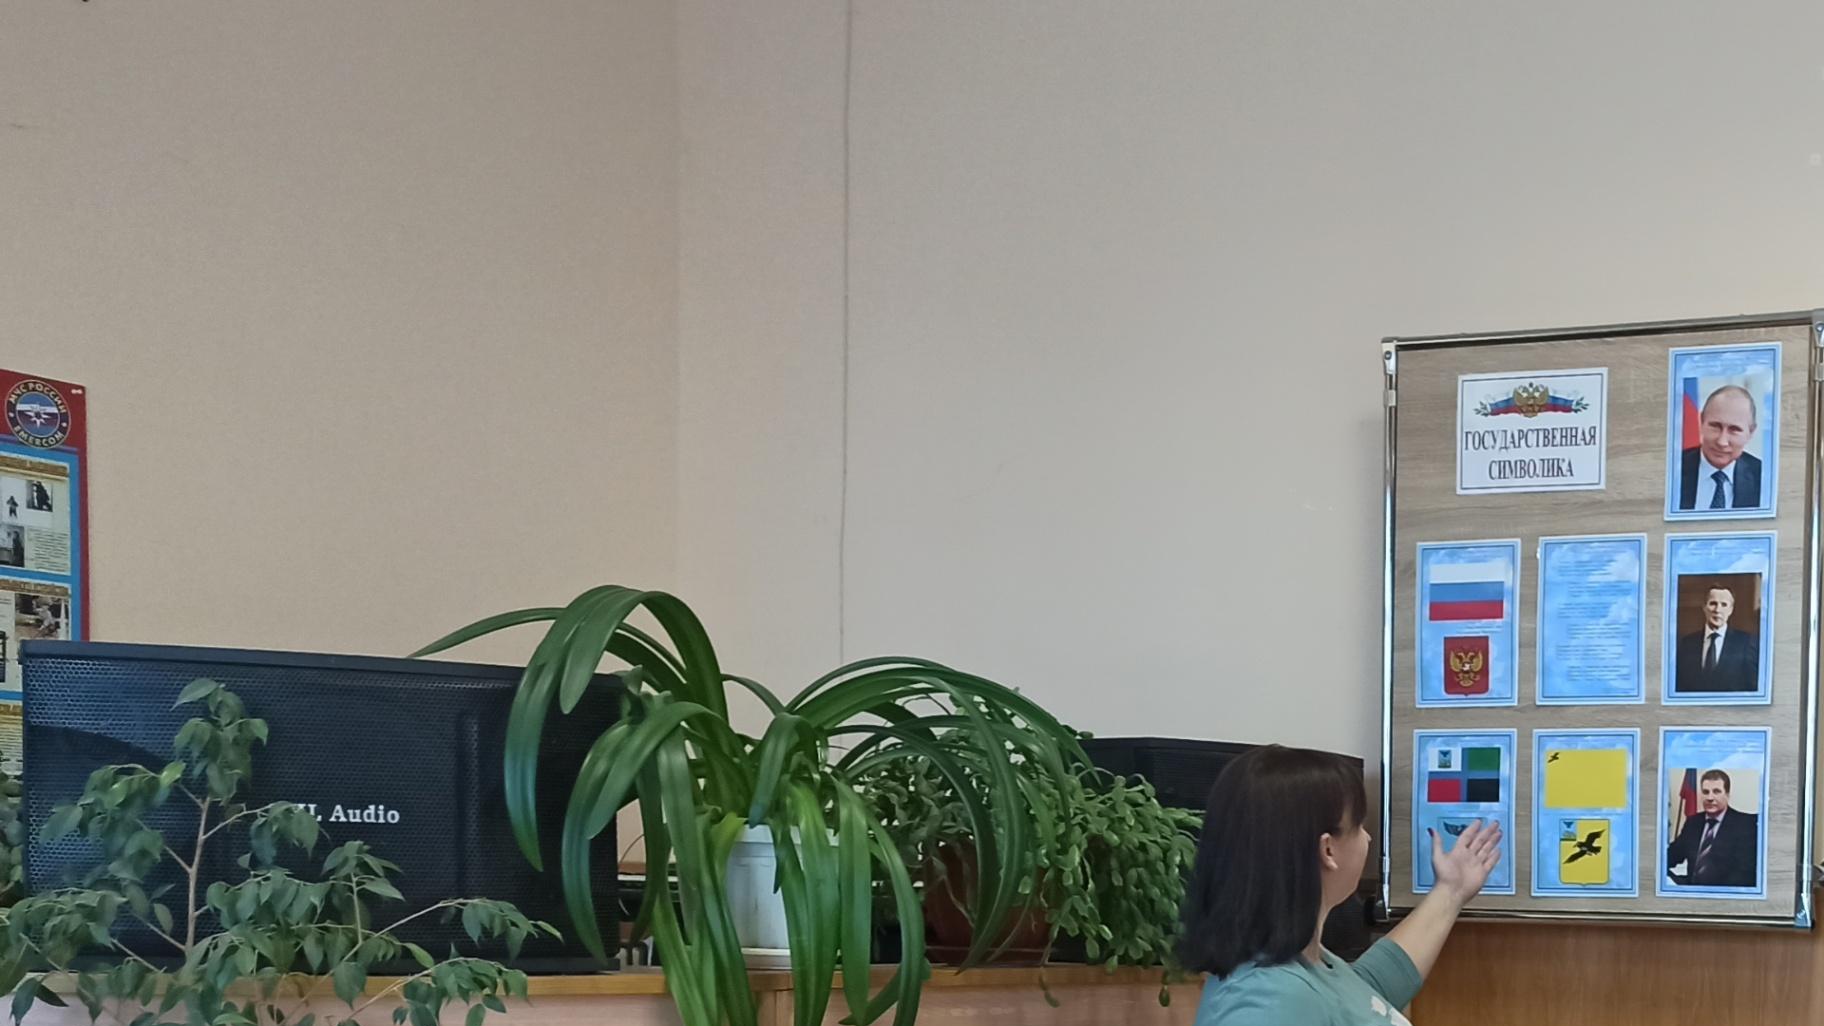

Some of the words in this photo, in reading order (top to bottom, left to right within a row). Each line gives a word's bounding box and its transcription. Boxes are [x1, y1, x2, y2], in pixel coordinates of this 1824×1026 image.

[9, 384, 28, 404] МЧС
[28, 382, 67, 414] РОССИИ
[14, 425, 65, 447] EMERCOM
[1464, 426, 1597, 451] ГОСУДАРСТВЕННАЯ
[1488, 458, 1574, 480] СИМВОЛИКА
[329, 804, 400, 823] Audio
